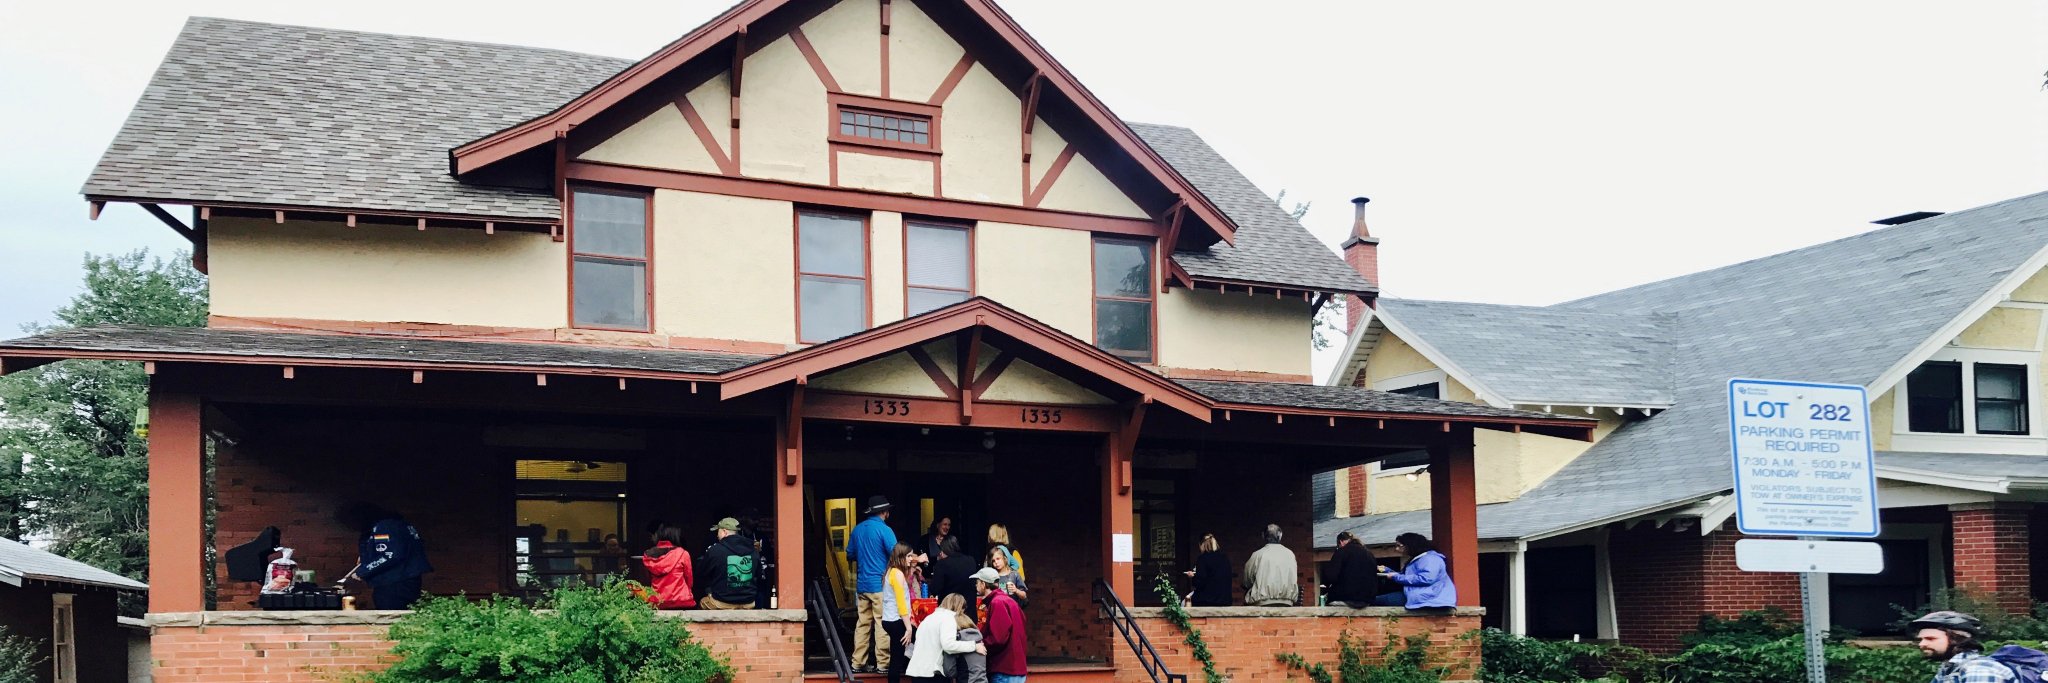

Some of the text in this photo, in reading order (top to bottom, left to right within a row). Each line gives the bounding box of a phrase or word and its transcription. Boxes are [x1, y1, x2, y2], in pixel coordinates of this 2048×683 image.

[863, 399, 910, 416] 1333
[1743, 401, 1851, 422] LOT 282
[1021, 408, 1062, 424] 1335
[1740, 426, 1861, 441] PARKING PERMIT
[1765, 440, 1840, 453] REQUIRED
[1743, 457, 1767, 466] 7:30
[1811, 460, 1837, 469] 5:00
[1752, 468, 1799, 478] MONDAY
[1815, 470, 1852, 480] FRIDAY
[1751, 485, 1862, 495] VIOLATORS SUBJECT TO
[1751, 491, 1769, 499] TOW
[1772, 492, 1782, 500] AT
[1826, 494, 1864, 503] EXPENSE
